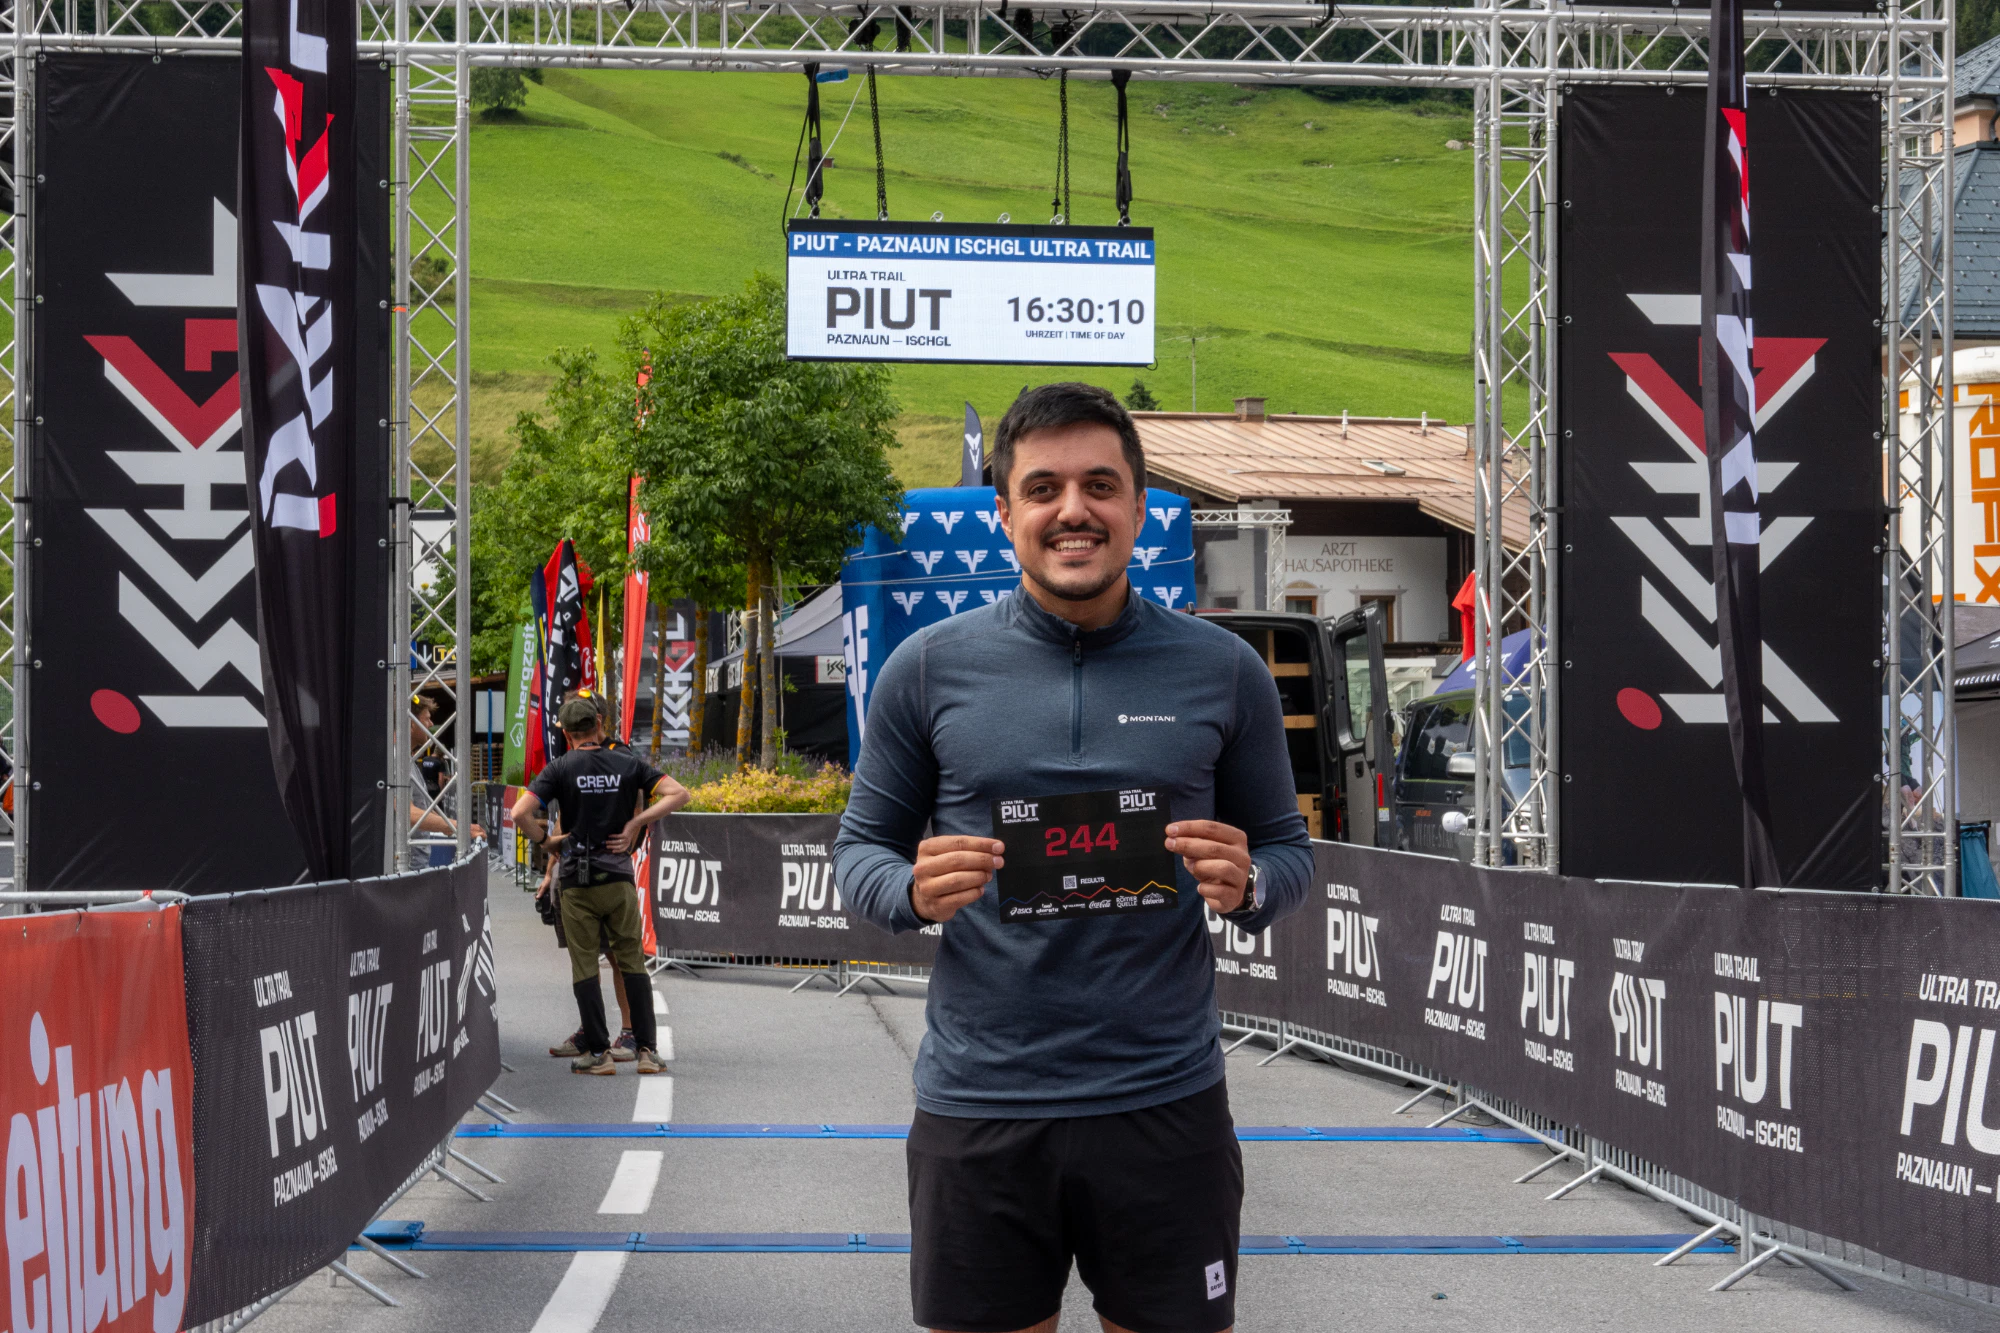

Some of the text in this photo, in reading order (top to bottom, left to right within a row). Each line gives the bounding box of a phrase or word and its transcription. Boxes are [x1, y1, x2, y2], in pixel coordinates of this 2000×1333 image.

[793, 234, 838, 251] PIUT
[857, 236, 951, 255] PAZNAUN
[955, 238, 1024, 256] ISCHGL
[1030, 240, 1091, 257] ULTRA
[1096, 242, 1151, 259] TRAIL
[827, 270, 906, 282] ULTRA TRAIL
[826, 286, 952, 331] PIUT
[1007, 297, 1145, 325] 16:30:10
[826, 333, 890, 346] PAZNAUN
[905, 335, 952, 347] ISCHGL
[1025, 330, 1064, 340] UHRZEIT
[1070, 331, 1092, 340] TIME
[1093, 331, 1106, 340] OF
[1107, 331, 1126, 340] DAY
[1321, 542, 1357, 556] ARZT
[1285, 559, 1394, 573] HAUSAPOTHEKE
[515, 623, 535, 718] bergzeit
[577, 774, 621, 788] CREW
[1001, 803, 1039, 819] PIUT
[1119, 792, 1156, 808] PIUT
[662, 841, 700, 854] ULTRA TRAIL
[781, 844, 827, 856] ULTRA TRAIL
[1045, 822, 1119, 857] 244
[657, 857, 722, 906] PIUT
[1080, 877, 1105, 885] RESULTS
[1327, 883, 1349, 900] ULTRA
[659, 907, 686, 920] PAZNAUN
[694, 910, 720, 923] ISCHGL
[778, 915, 810, 928] PAZNAUN
[817, 916, 849, 930] ISCHGL
[1441, 904, 1476, 927] ULTRA TRAIL
[1327, 907, 1381, 981] PIUT
[1524, 922, 1555, 945] ULTRA TRAIL
[1613, 938, 1632, 961] ULTRA
[350, 951, 366, 977] ULTRA
[1250, 962, 1278, 980] ISCHGL
[1427, 930, 1487, 1012] PIUT
[1714, 952, 1760, 982] ULTRA TRAIL
[1327, 978, 1359, 1000] PAZNAUN
[1366, 986, 1387, 1007] ISCHGL
[1520, 952, 1575, 1040] PIUT
[1918, 973, 1969, 1006] ULTRA
[416, 959, 451, 1063] PIUT
[1424, 1007, 1461, 1032] PAZNAUN
[1466, 1015, 1486, 1040] ISCHGL
[1609, 971, 1666, 1071] PIUT
[348, 982, 393, 1103] PIUT
[1714, 991, 1803, 1110] PIUT
[1553, 1048, 1574, 1073] ISCHGL
[260, 1011, 327, 1158] PIUT
[1615, 1068, 1641, 1098] PAZNAUN
[1646, 1080, 1667, 1107] ISCHGL
[1755, 1120, 1803, 1152] ISCHGL
[0, 1011, 185, 1333] eitung
[274, 1160, 313, 1207] PAZNAUN
[318, 1145, 337, 1182] ISCHGL
[1896, 1151, 1973, 1196] PAZNAUN
